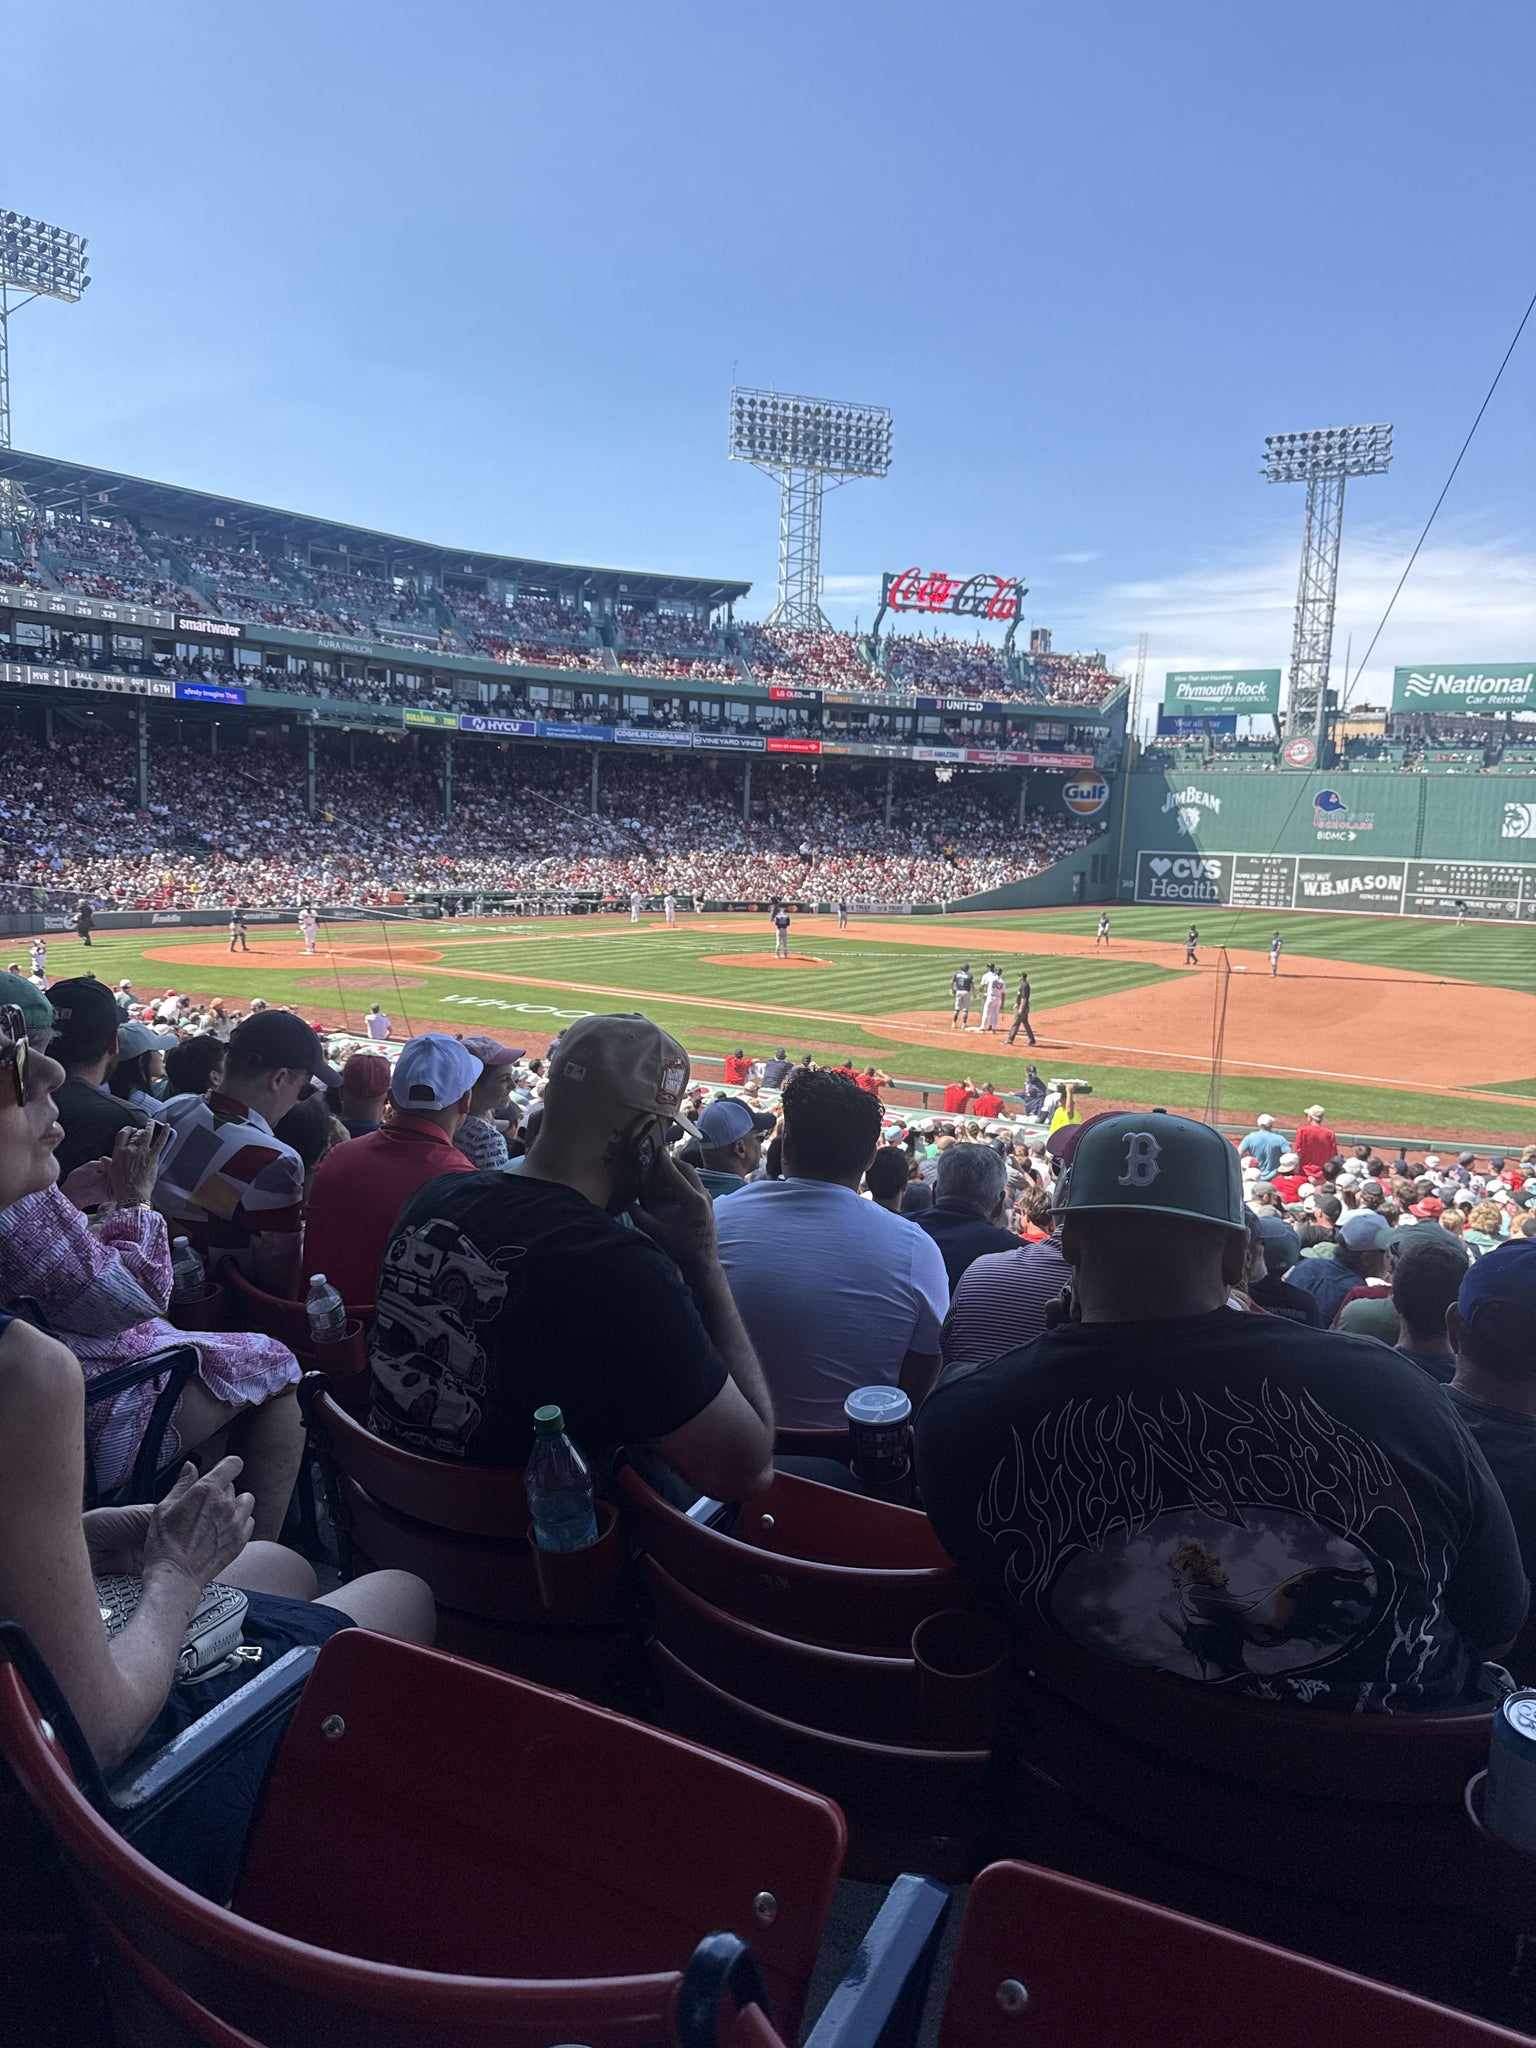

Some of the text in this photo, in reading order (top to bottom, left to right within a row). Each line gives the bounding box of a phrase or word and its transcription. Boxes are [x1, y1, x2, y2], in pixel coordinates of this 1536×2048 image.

[889, 567, 1024, 619] Coca-Cola
[23, 599, 38, 608] .192
[49, 603, 66, 612] .260
[75, 607, 92, 616] .269
[100, 610, 117, 619] .529
[131, 614, 136, 622] 2
[179, 619, 240, 637] smartwater
[318, 639, 341, 649] AURA
[32, 672, 50, 681] MVR
[75, 672, 93, 680] BALL
[103, 675, 125, 684] STRIKE
[131, 678, 144, 686] OUT
[1433, 673, 1534, 694] National
[153, 684, 170, 694] 6TH
[184, 688, 202, 697] xfinity
[203, 689, 224, 699] Imagine
[1176, 681, 1267, 698] Plymouth Rock
[1465, 695, 1527, 704] Car Rental
[947, 699, 983, 712] UNITED
[488, 721, 519, 731] HYCU
[702, 738, 763, 747] VINEYARD VINES
[1064, 784, 1106, 799] Gulf
[1317, 831, 1346, 841] BIDMC
[1172, 858, 1222, 880] CVS
[1434, 864, 1523, 875] FENWAY PARK
[1455, 872, 1461, 880] 2
[1462, 872, 1468, 880] 3
[1477, 873, 1482, 881] 5
[1483, 873, 1489, 881] 6
[1497, 874, 1503, 882] 8
[1150, 879, 1218, 900] Health
[1303, 874, 1402, 896] W.B.MASON
[1359, 893, 1381, 901] SINCE
[438, 994, 597, 1018] WHOO
[1117, 1132, 1163, 1187] B
